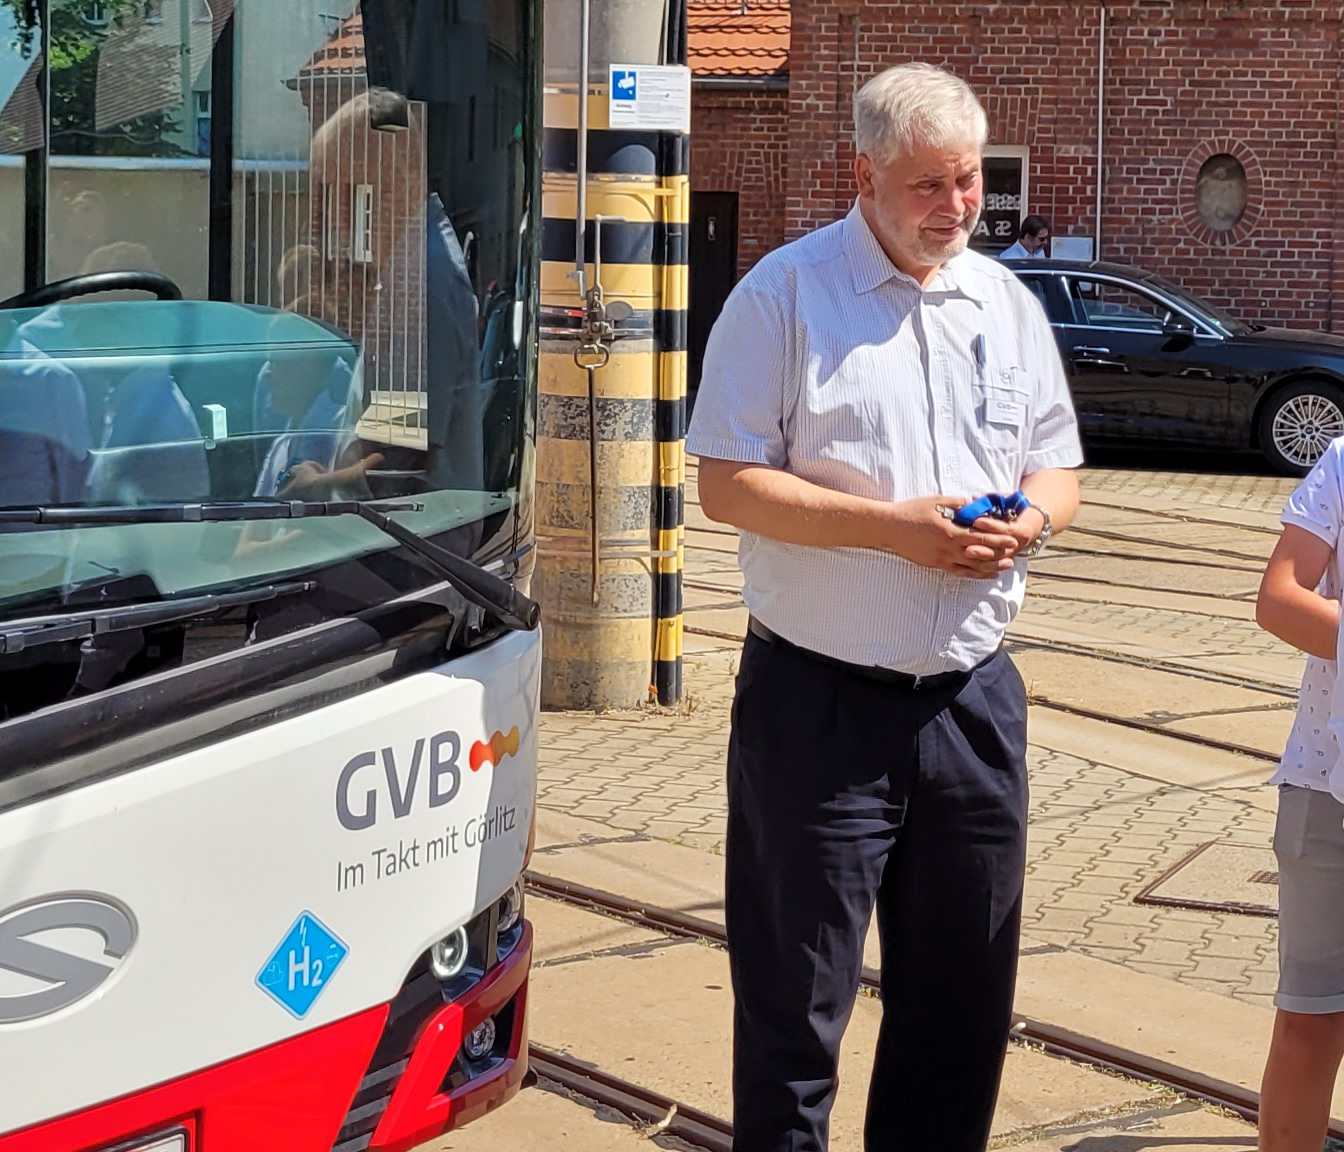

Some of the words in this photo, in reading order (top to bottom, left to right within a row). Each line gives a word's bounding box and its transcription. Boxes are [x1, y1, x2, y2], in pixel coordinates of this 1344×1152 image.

[336, 730, 461, 831] GVB
[337, 862, 364, 892] Im
[372, 839, 420, 880] Takt
[426, 827, 459, 864] mit
[464, 805, 516, 848] Görlitz
